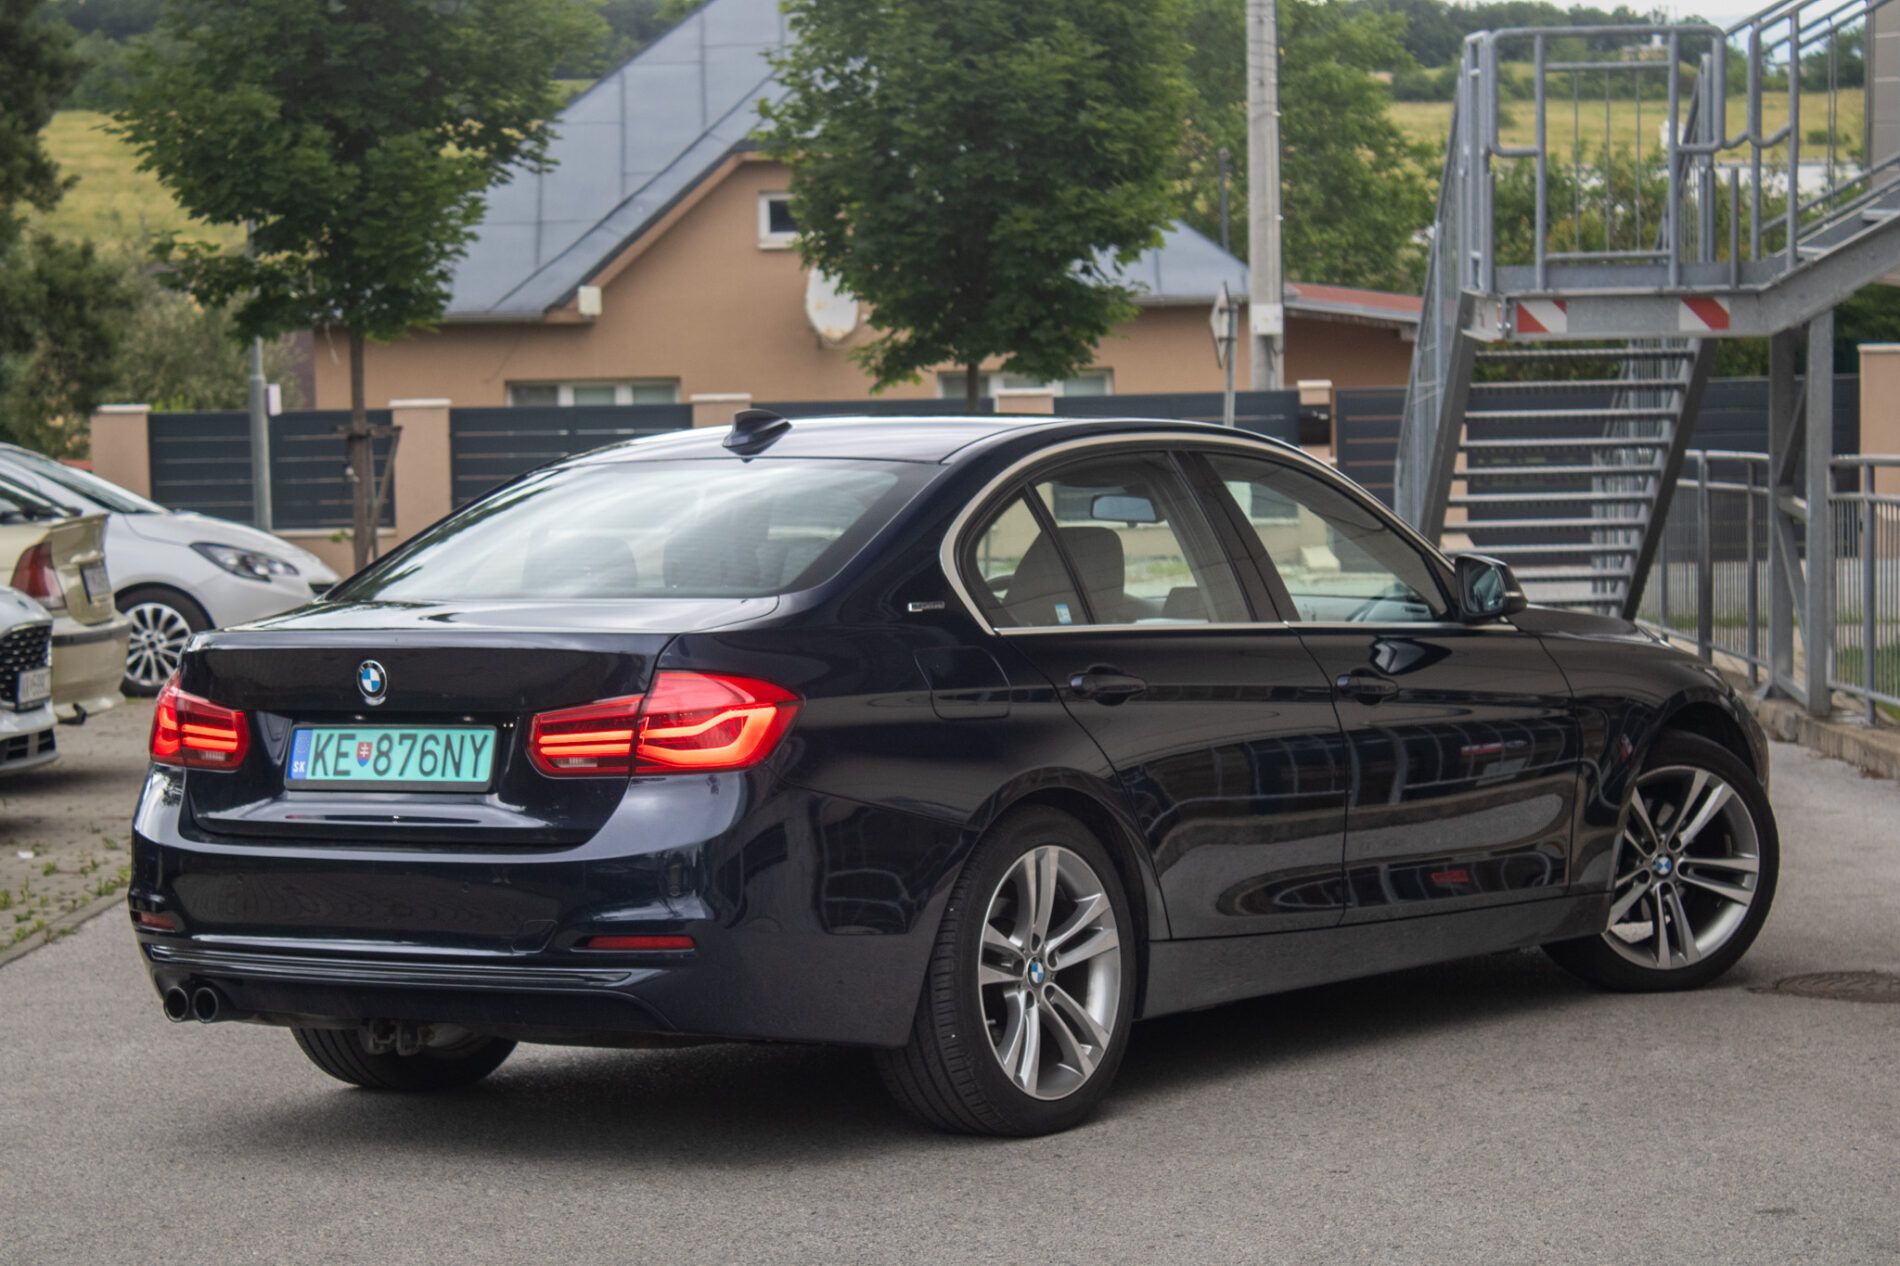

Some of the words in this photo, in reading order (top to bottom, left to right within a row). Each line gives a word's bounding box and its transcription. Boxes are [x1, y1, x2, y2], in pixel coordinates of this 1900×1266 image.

[293, 761, 305, 772] SK
[311, 733, 356, 777] KE
[373, 733, 488, 778] 876NY
